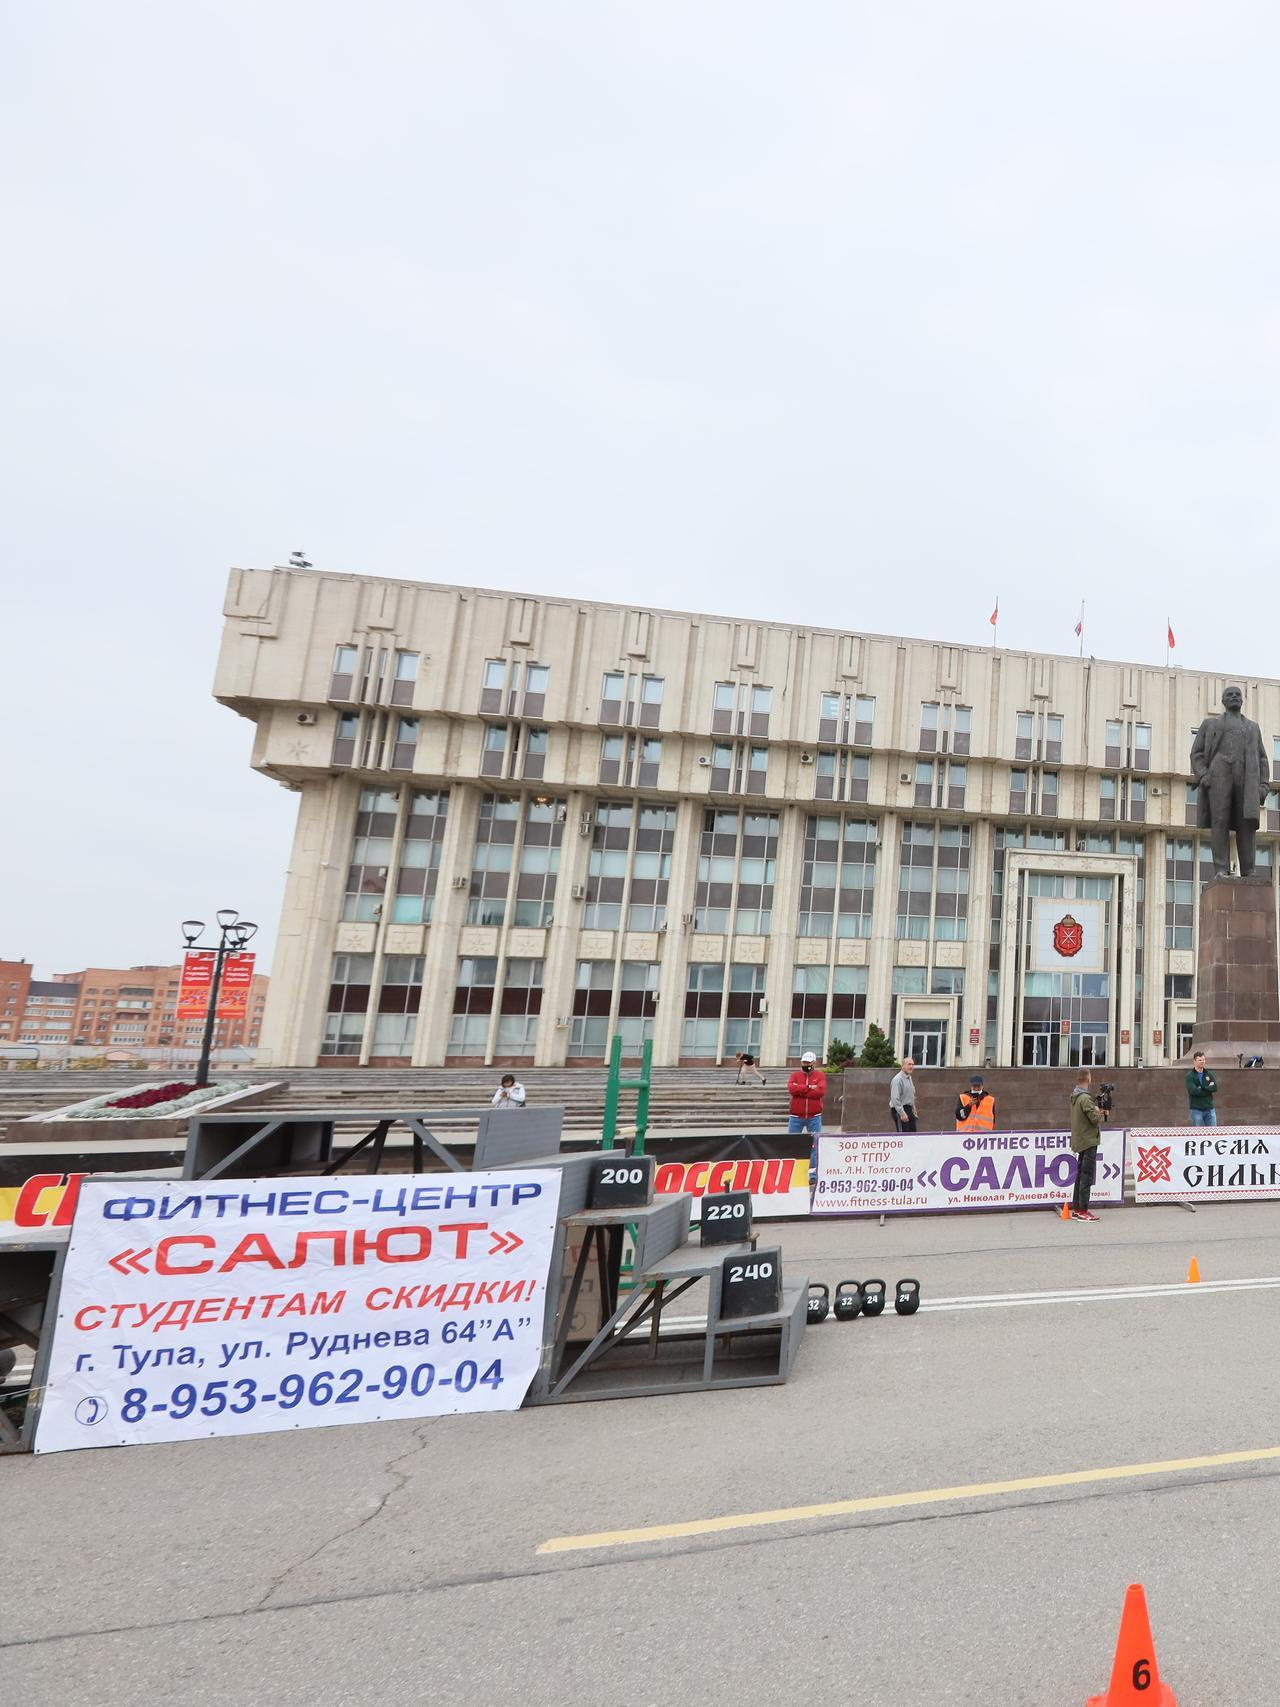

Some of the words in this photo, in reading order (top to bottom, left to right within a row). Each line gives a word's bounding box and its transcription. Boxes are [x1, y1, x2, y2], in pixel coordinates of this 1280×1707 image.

[838, 1140, 859, 1152] 300
[861, 1140, 904, 1151] метров
[962, 1136, 1030, 1151] ФИТНЕС
[1034, 1135, 1072, 1151] ЦЕНТ
[844, 1154, 858, 1163] от
[861, 1152, 891, 1163] ТГПУ
[600, 1169, 643, 1184] 200
[845, 1166, 865, 1175] Л.Н.
[868, 1165, 912, 1175] Толстого
[818, 1178, 914, 1194] 8-953-962-90-04
[103, 1183, 542, 1221] ФИТНЕС-ЦЕНТР
[815, 1196, 928, 1208] www.fitness-tula.ru
[963, 1194, 1005, 1203] Николая
[1008, 1193, 1048, 1201] Руднева
[707, 1204, 745, 1220] 220
[108, 1222, 525, 1276] «САЛЮТ»
[729, 1263, 773, 1283] 240
[808, 1300, 820, 1310] 32
[841, 1297, 853, 1306] 32
[867, 1295, 878, 1304] 24
[899, 1294, 910, 1303] 24
[74, 1290, 347, 1333] СТУДЕНТАМ
[365, 1280, 537, 1312] СКИДКИ!
[76, 1353, 94, 1372] г.
[113, 1345, 205, 1376] Тула,
[218, 1340, 271, 1369] ул.
[285, 1328, 430, 1360] Руднева
[120, 1359, 505, 1424] 8-953-962-90-04
[1132, 1658, 1151, 1691] 6
